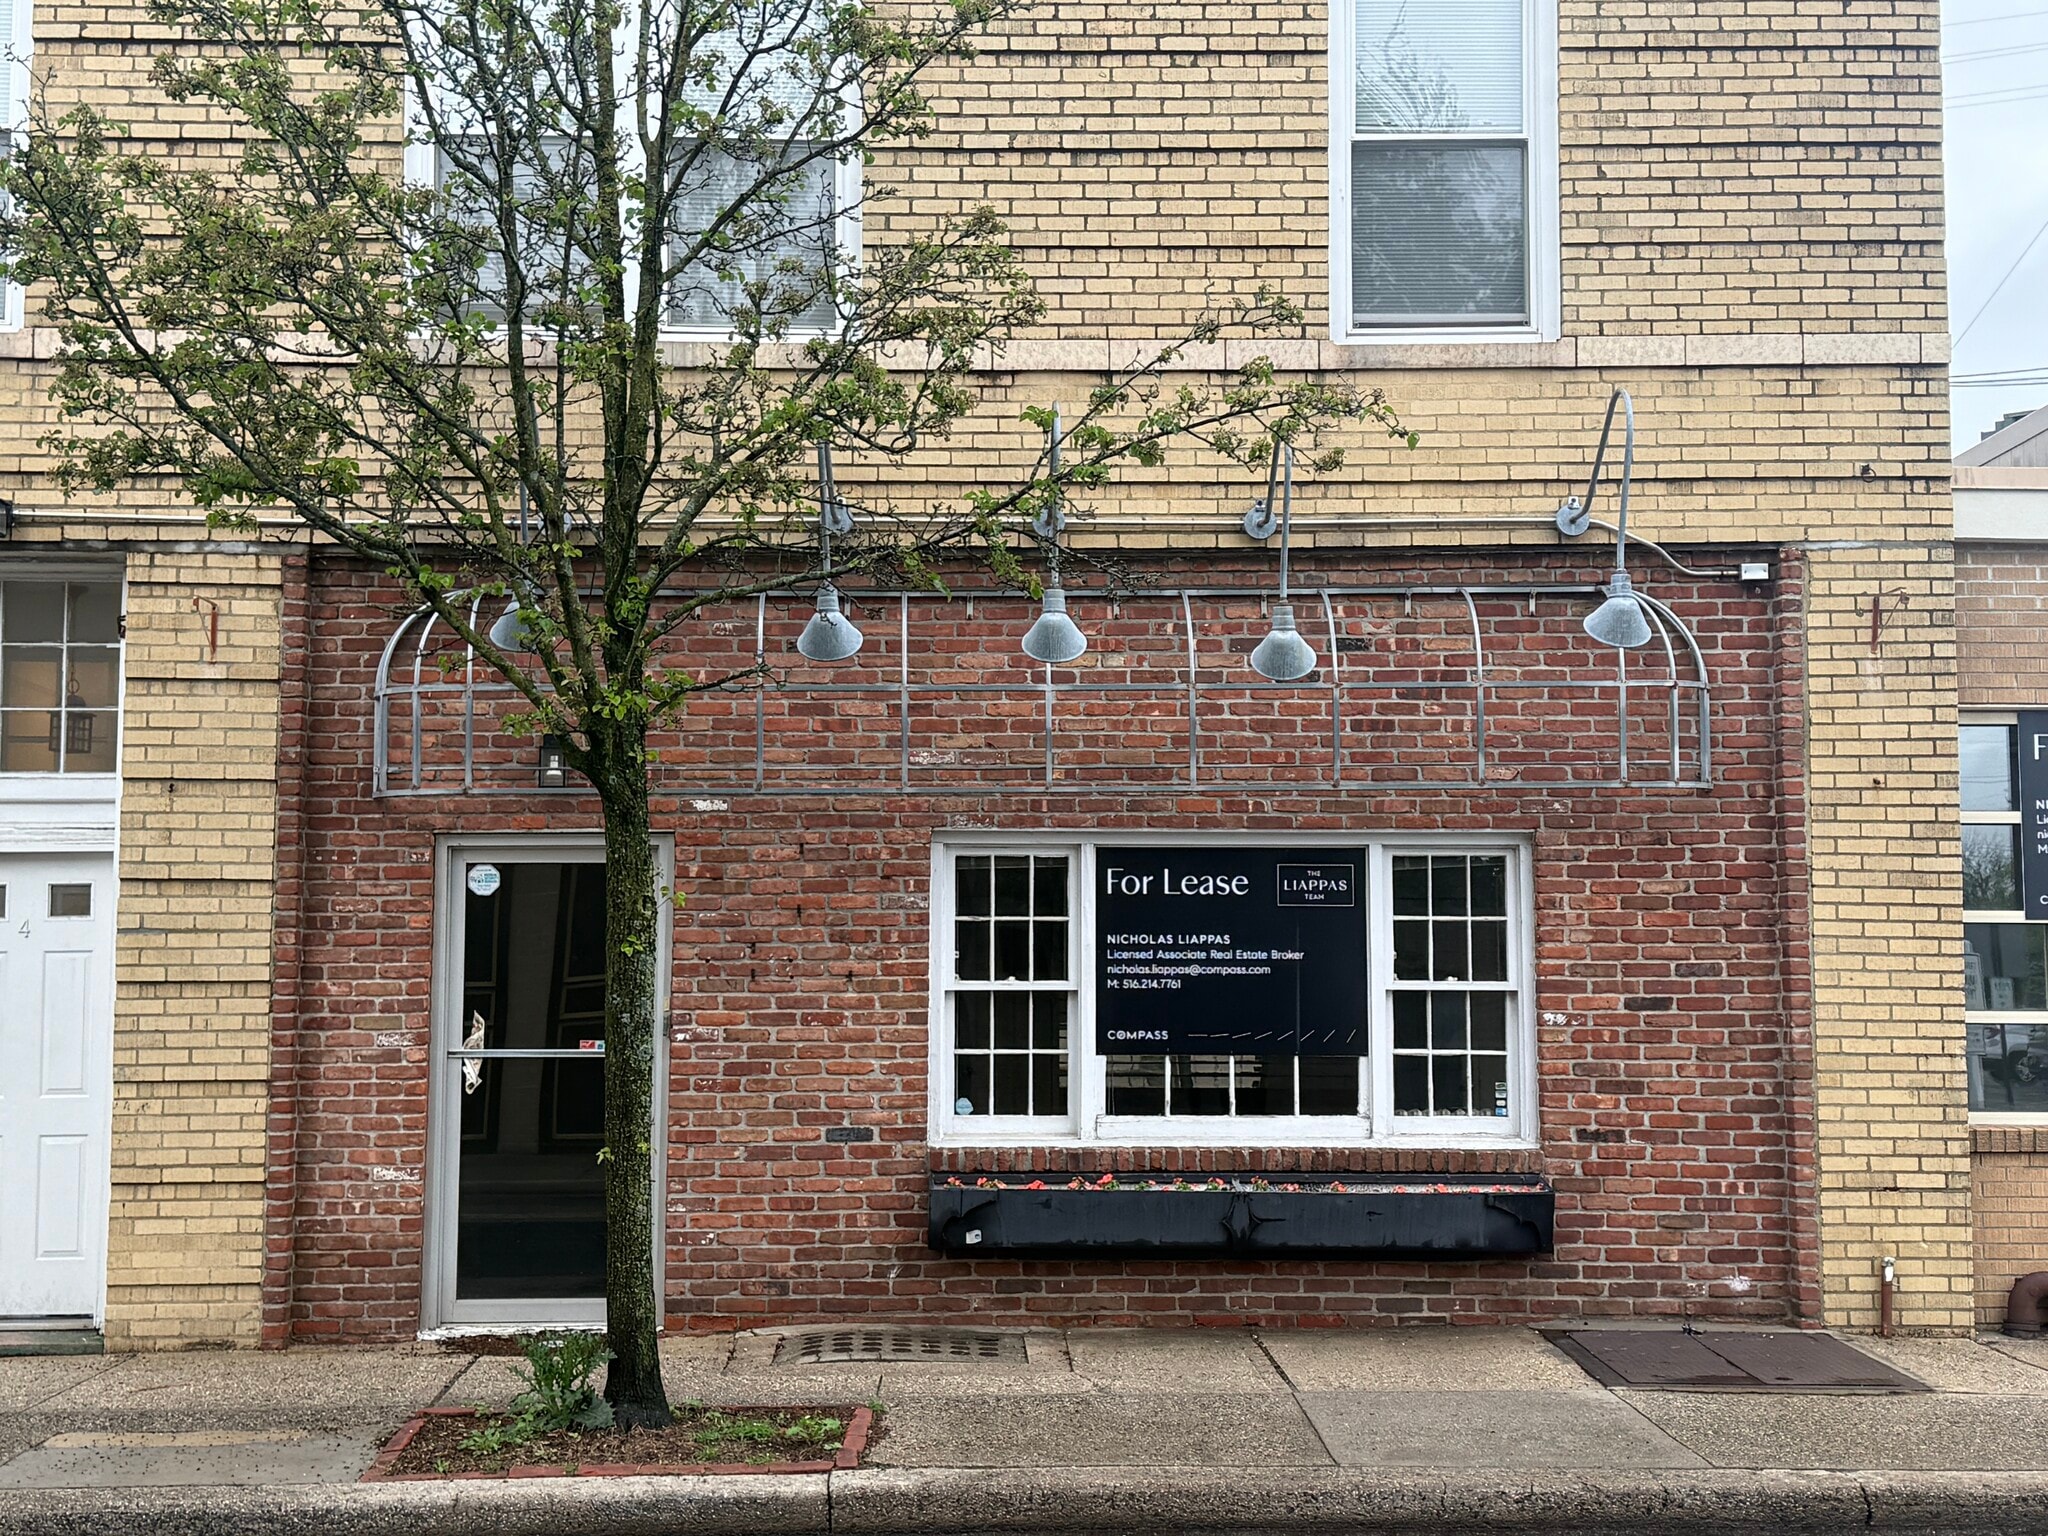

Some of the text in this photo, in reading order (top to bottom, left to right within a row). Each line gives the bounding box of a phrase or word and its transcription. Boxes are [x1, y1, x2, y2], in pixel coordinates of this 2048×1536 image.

[1106, 867, 1249, 896] For Lease
[1283, 879, 1348, 892] LIAPPAS
[1304, 893, 1325, 901] TEAM
[18, 919, 31, 939] 4
[1106, 933, 1231, 945] NICHOLAS LIAPPAS
[1106, 948, 1305, 960] Licensed Associate Real Estate Broker
[1106, 963, 1271, 977] nicholas.liappas@compass.com
[1122, 978, 1182, 989] 516.214.7761
[1106, 1029, 1169, 1041] COMPASS
